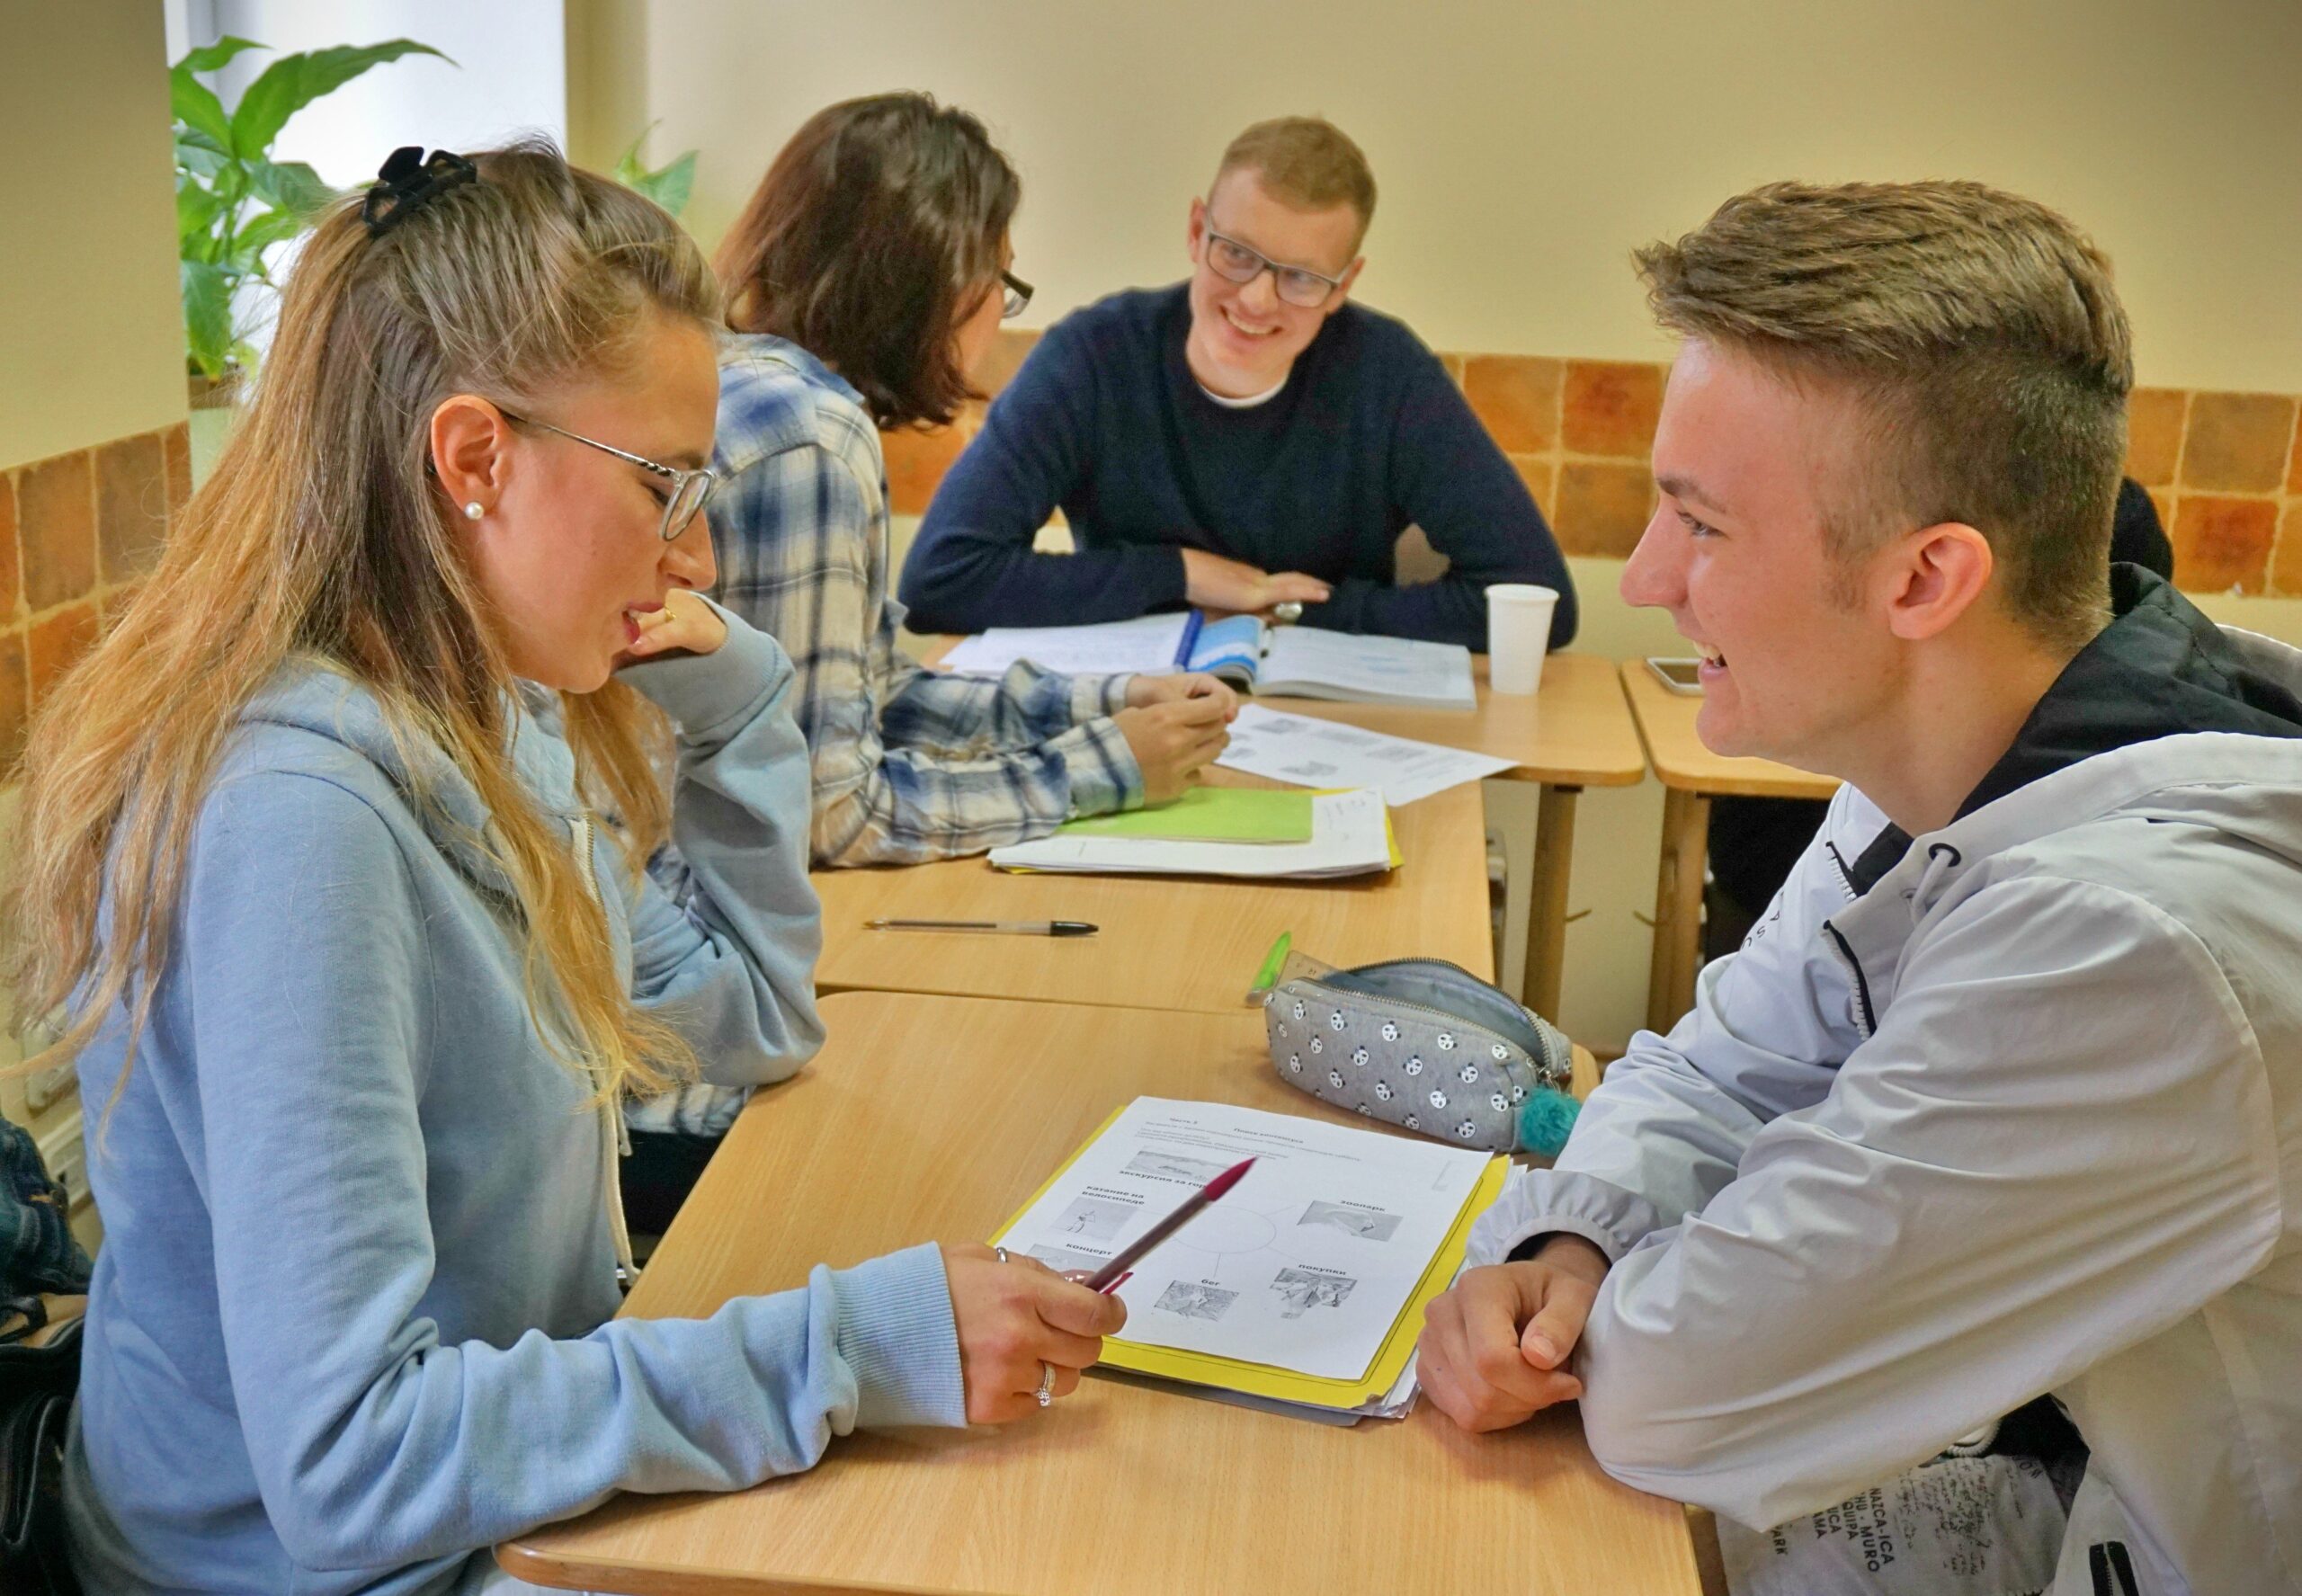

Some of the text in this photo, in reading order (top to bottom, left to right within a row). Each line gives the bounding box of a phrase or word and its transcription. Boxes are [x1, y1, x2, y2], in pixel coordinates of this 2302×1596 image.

[1119, 1170, 1172, 1183] экскурсия
[1081, 1190, 1145, 1205] велосипеде
[1086, 1185, 1126, 1197] катание
[1339, 1199, 1386, 1212] зоопарк
[1066, 1243, 1113, 1256] концерт
[1298, 1263, 1347, 1276] покупки
[1200, 1279, 1220, 1287] бег
[1812, 1511, 1827, 1539] AMA
[1826, 1506, 1842, 1534] UCA
[1842, 1500, 1860, 1540] QUIPA
[1869, 1486, 1895, 1565] NAZCA-ICA
[1854, 1493, 1880, 1573] HU MURO
